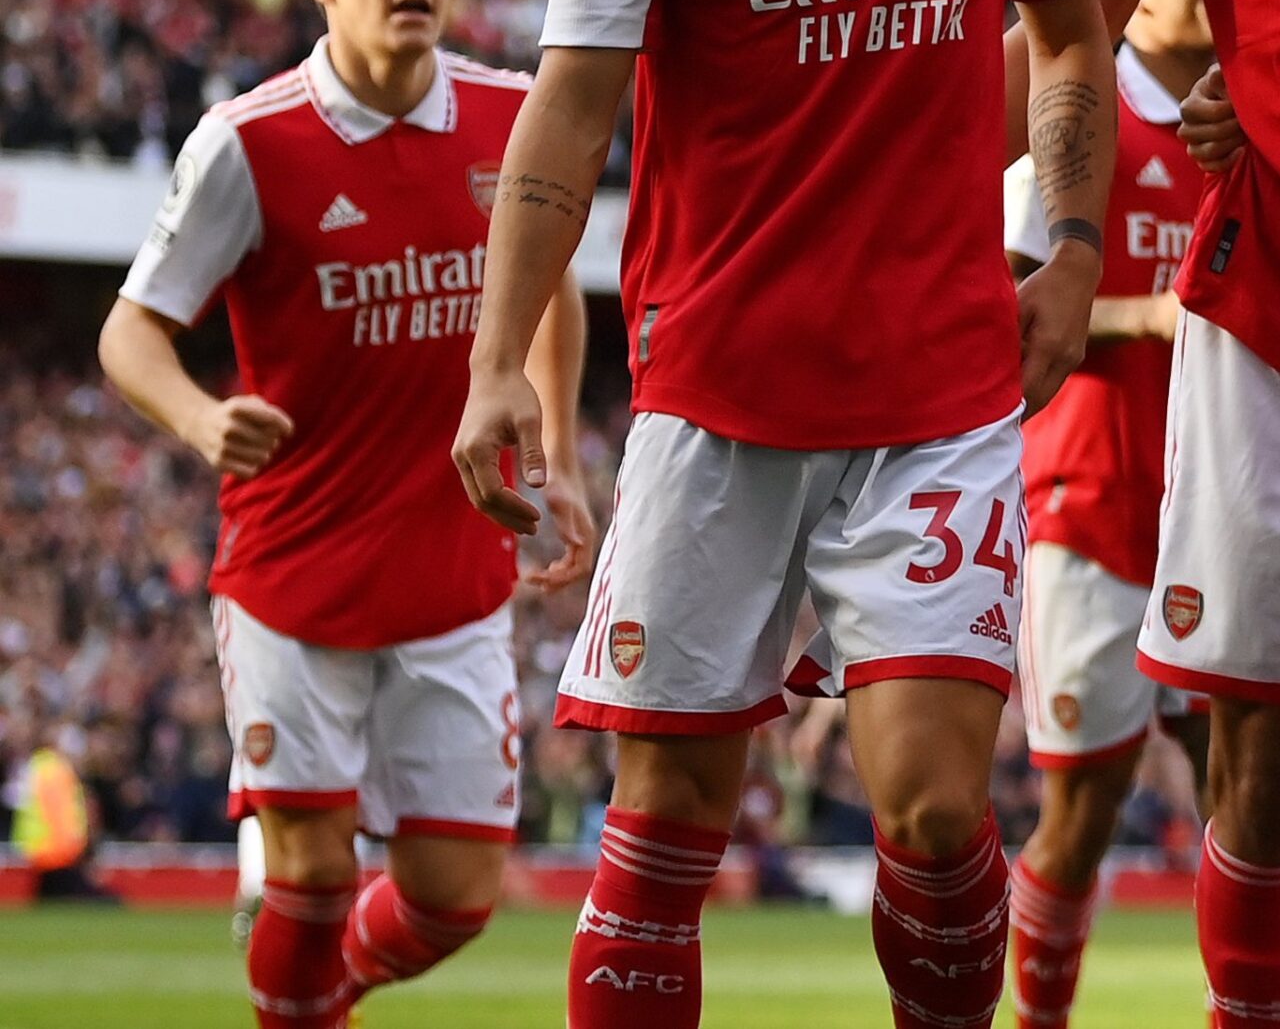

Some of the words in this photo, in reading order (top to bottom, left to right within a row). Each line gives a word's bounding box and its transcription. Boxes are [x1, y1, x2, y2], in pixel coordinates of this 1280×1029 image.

[798, 11, 855, 64] FLY
[353, 304, 401, 347] FLY
[905, 490, 1018, 598] 34
[970, 623, 1012, 646] adidas
[585, 965, 684, 993] AFC
[910, 941, 1004, 978] AFC
